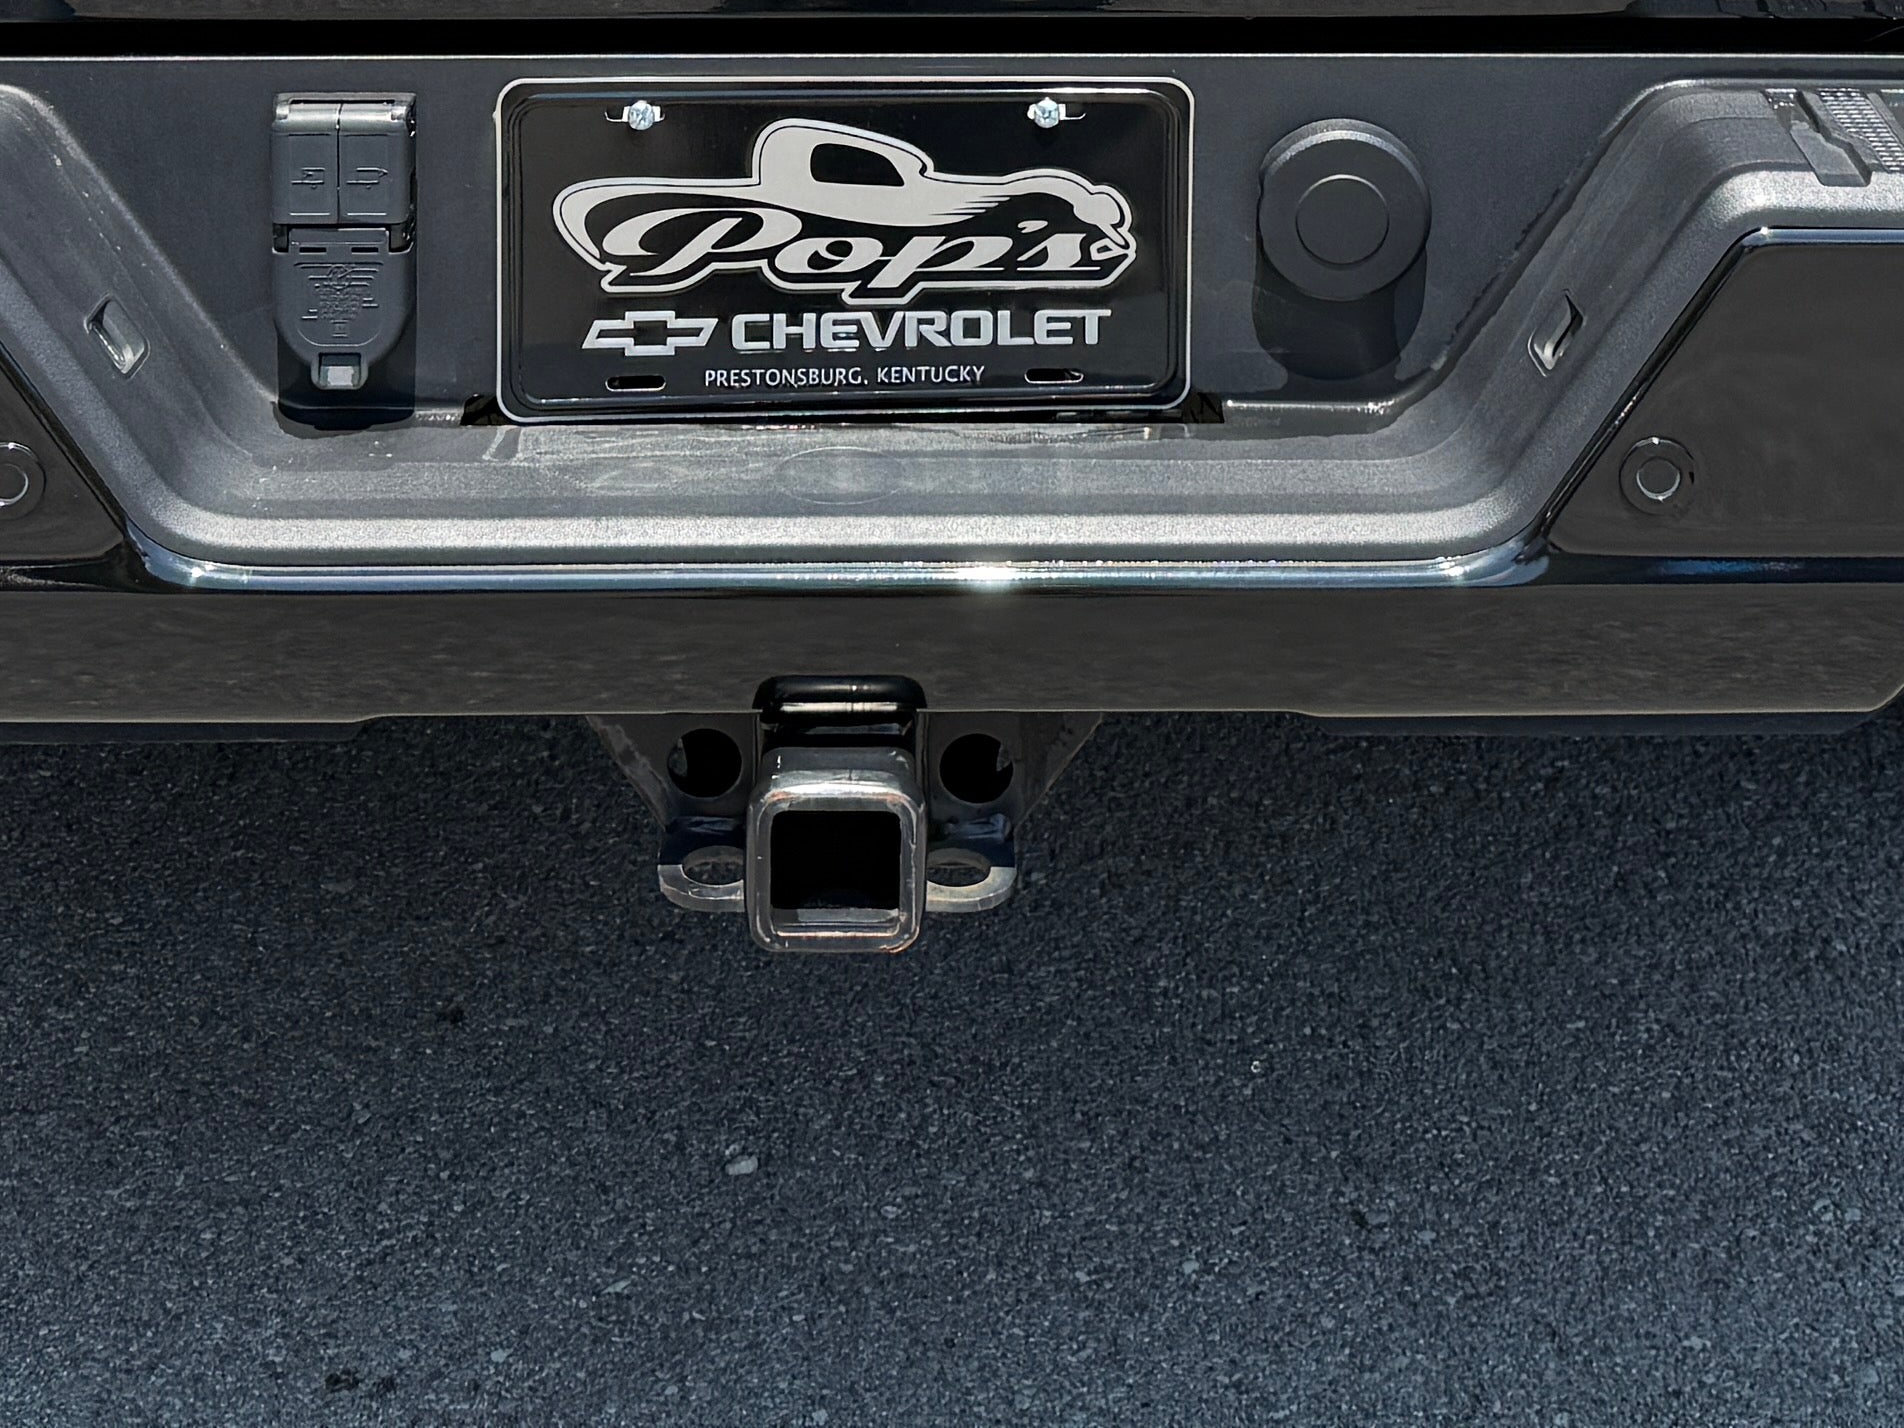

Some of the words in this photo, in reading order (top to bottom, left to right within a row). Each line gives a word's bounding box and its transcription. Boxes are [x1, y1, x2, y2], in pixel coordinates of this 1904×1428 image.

[601, 207, 1103, 290] Pop's
[730, 308, 1113, 352] CHEVROLET
[876, 364, 986, 385] KENTUCKY
